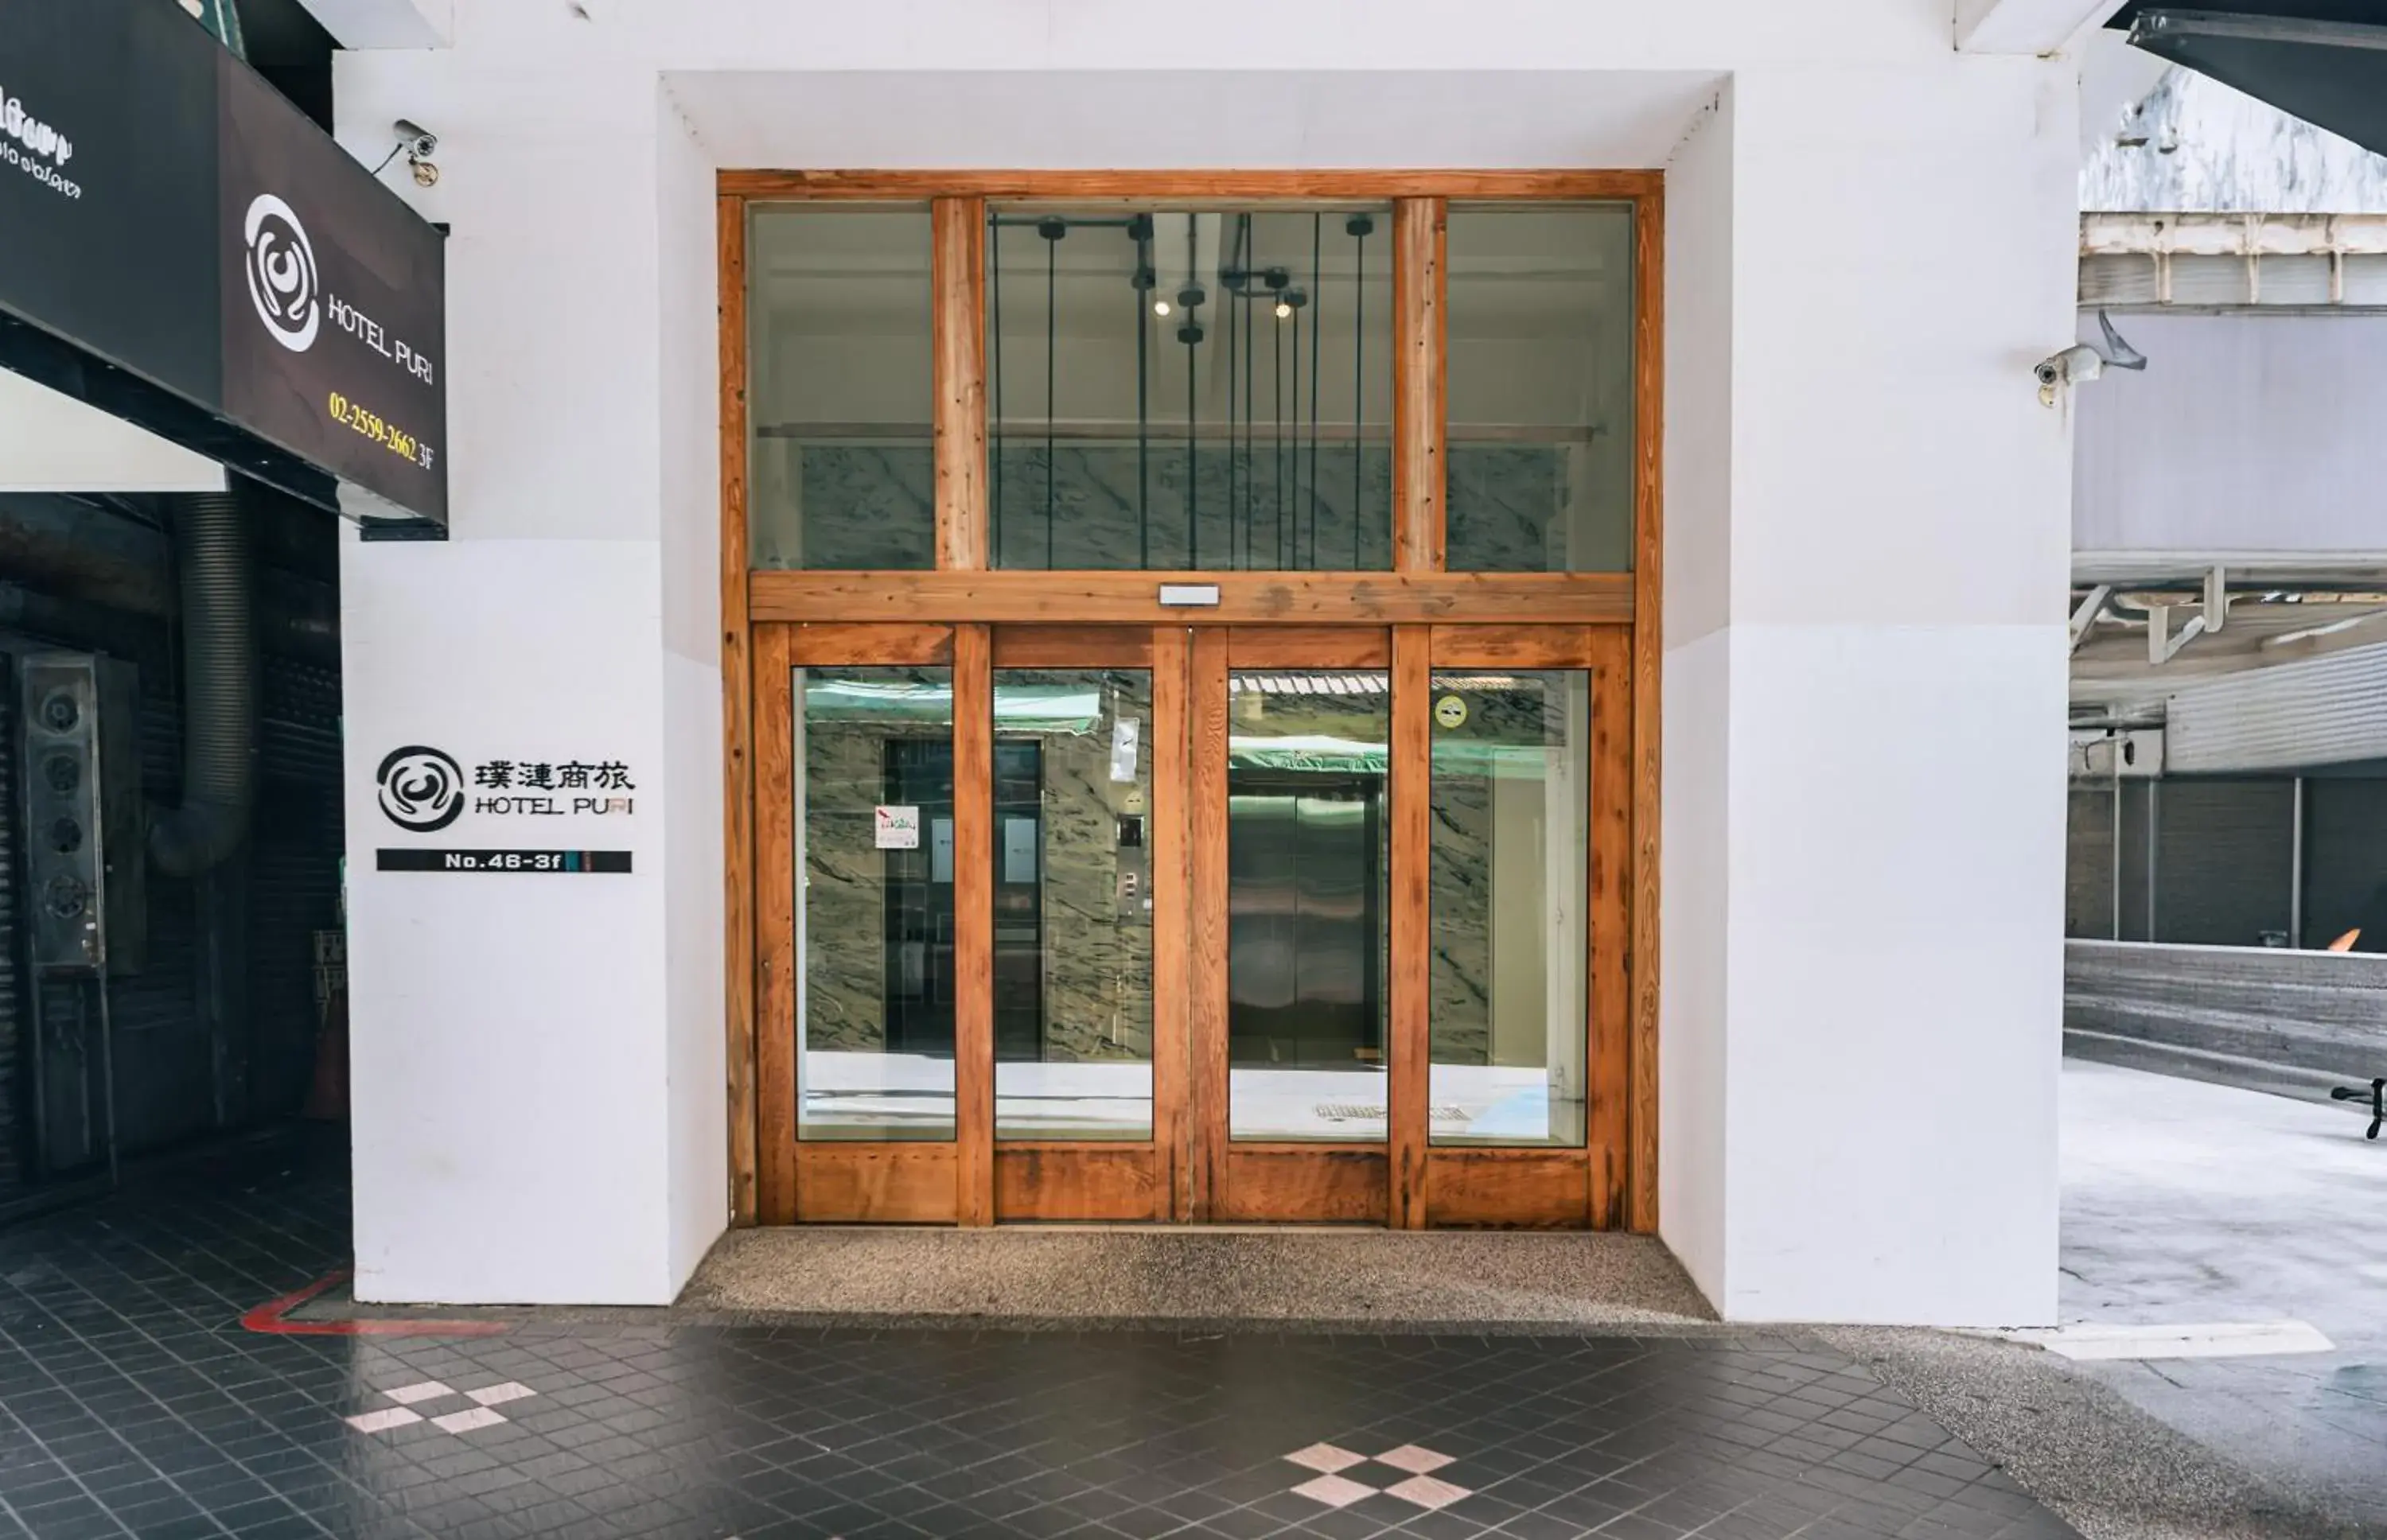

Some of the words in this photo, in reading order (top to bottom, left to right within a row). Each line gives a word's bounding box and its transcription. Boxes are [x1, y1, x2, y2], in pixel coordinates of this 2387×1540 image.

[329, 293, 391, 358] HOTEL
[395, 340, 434, 386] PURI
[329, 392, 418, 462] 02-2559-2662
[419, 443, 434, 470] 3F
[475, 797, 565, 815] HOTEL
[573, 798, 634, 815] PURI
